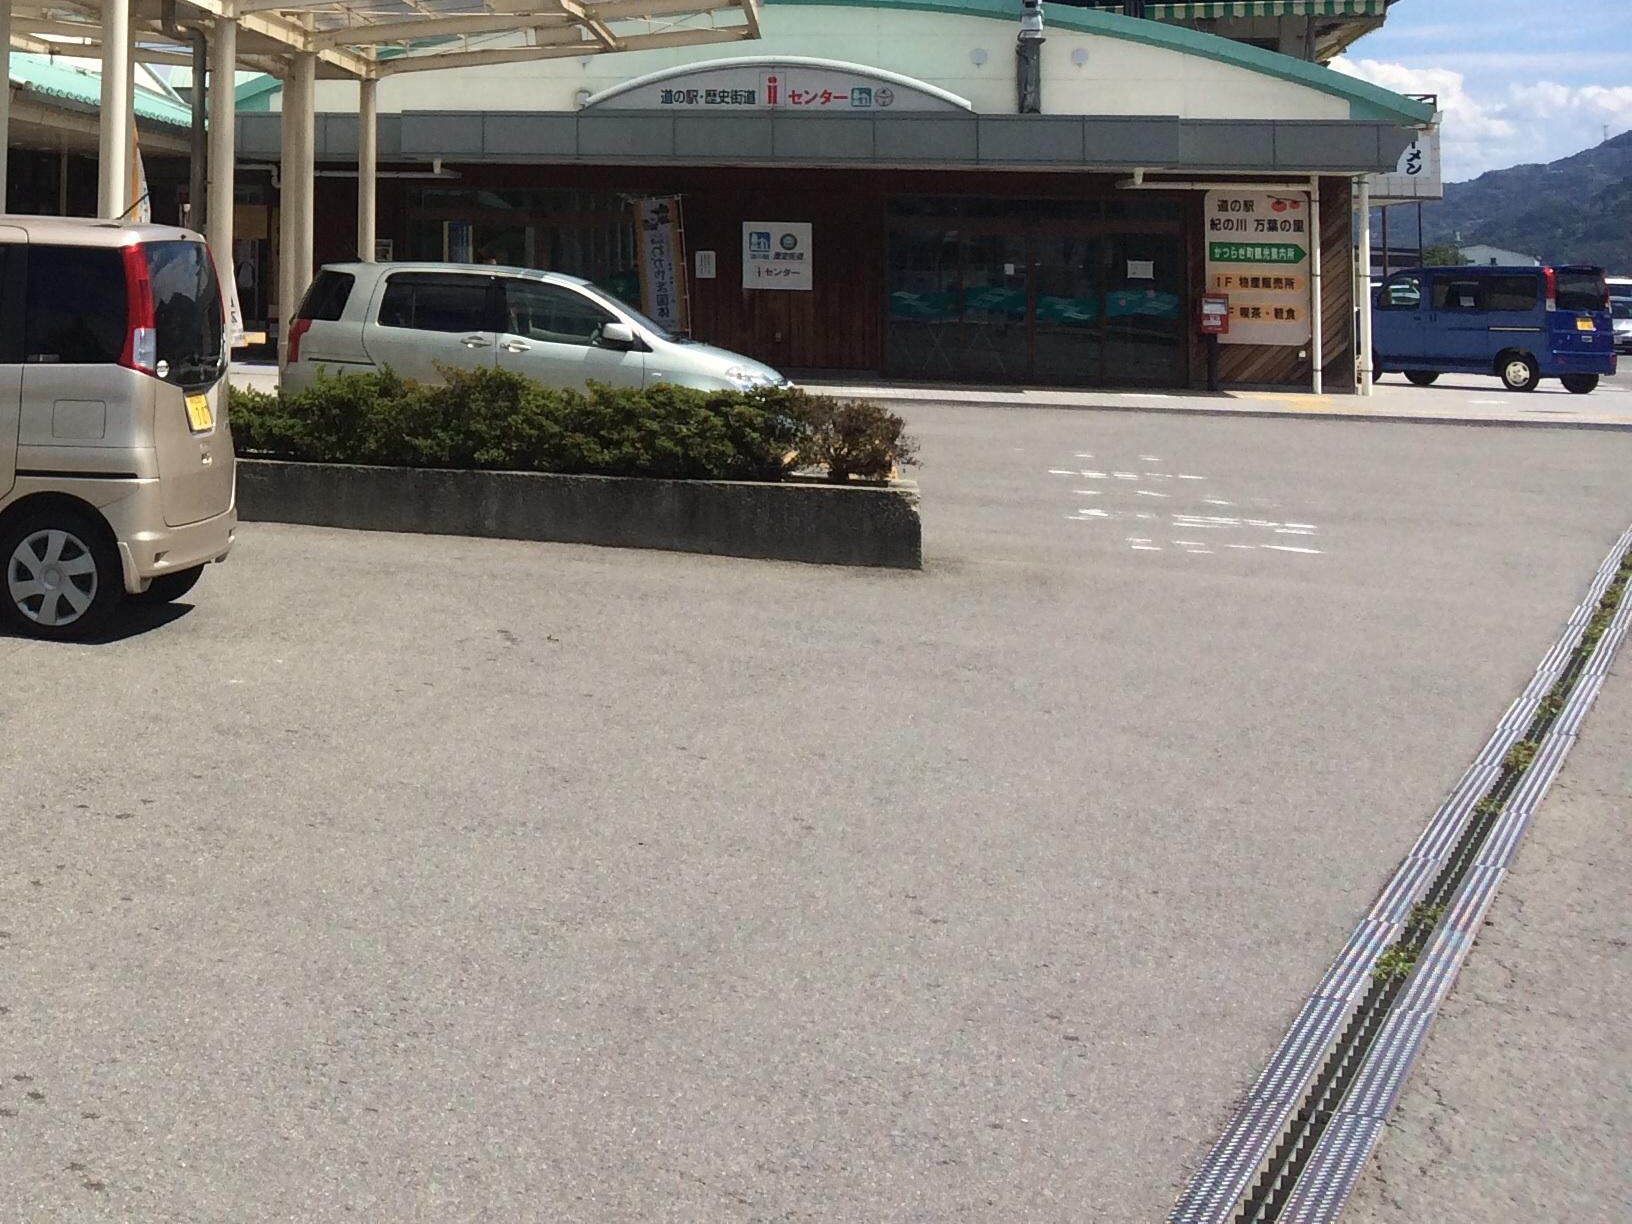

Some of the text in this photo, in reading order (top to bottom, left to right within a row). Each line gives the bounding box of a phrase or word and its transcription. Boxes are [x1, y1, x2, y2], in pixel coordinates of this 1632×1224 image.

[660, 88, 757, 106] 道の駅・歴史街道
[788, 88, 849, 106] センター
[1217, 199, 1255, 213] 道の駅
[1209, 218, 1305, 233] 紀の川 万葉の里
